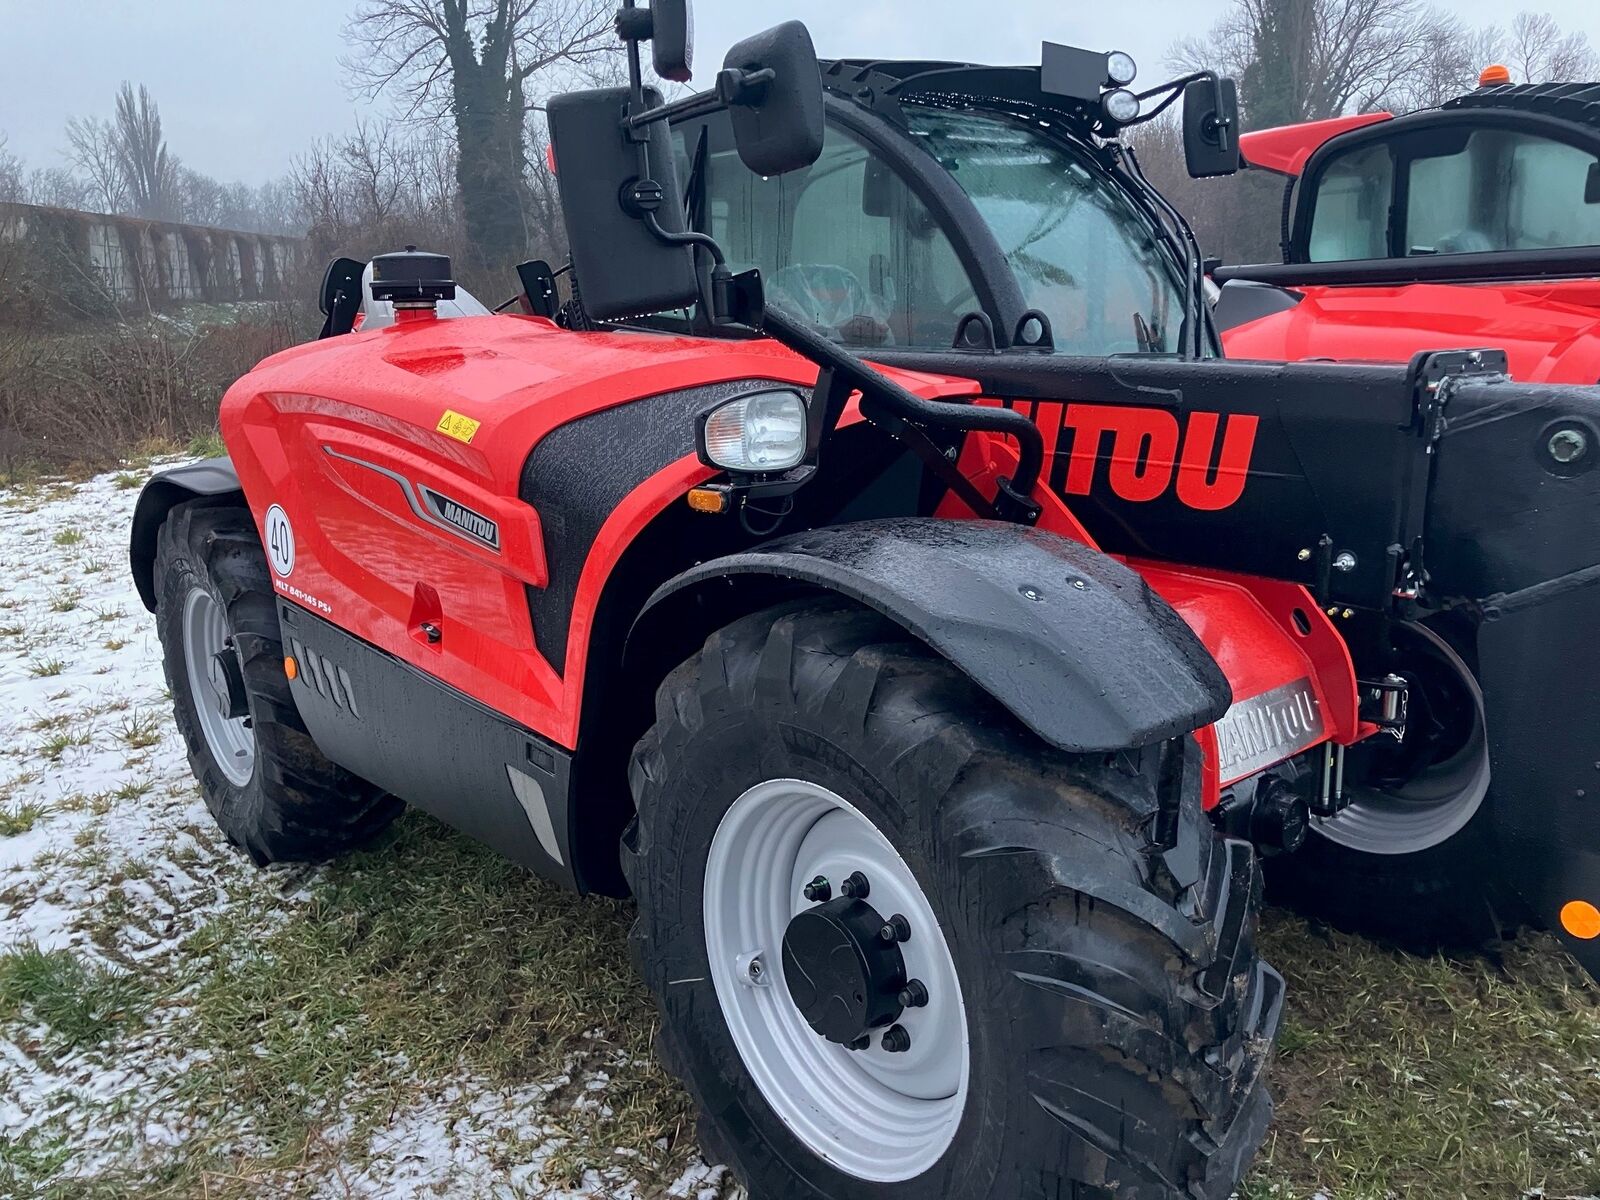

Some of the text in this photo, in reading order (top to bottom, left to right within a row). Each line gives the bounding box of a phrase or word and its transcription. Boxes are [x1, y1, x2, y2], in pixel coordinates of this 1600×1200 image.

[971, 397, 1260, 511] ITOU
[271, 517, 289, 565] 40
[444, 502, 494, 540] MANITOU
[275, 579, 289, 592] MLT
[289, 586, 317, 607] 841-145
